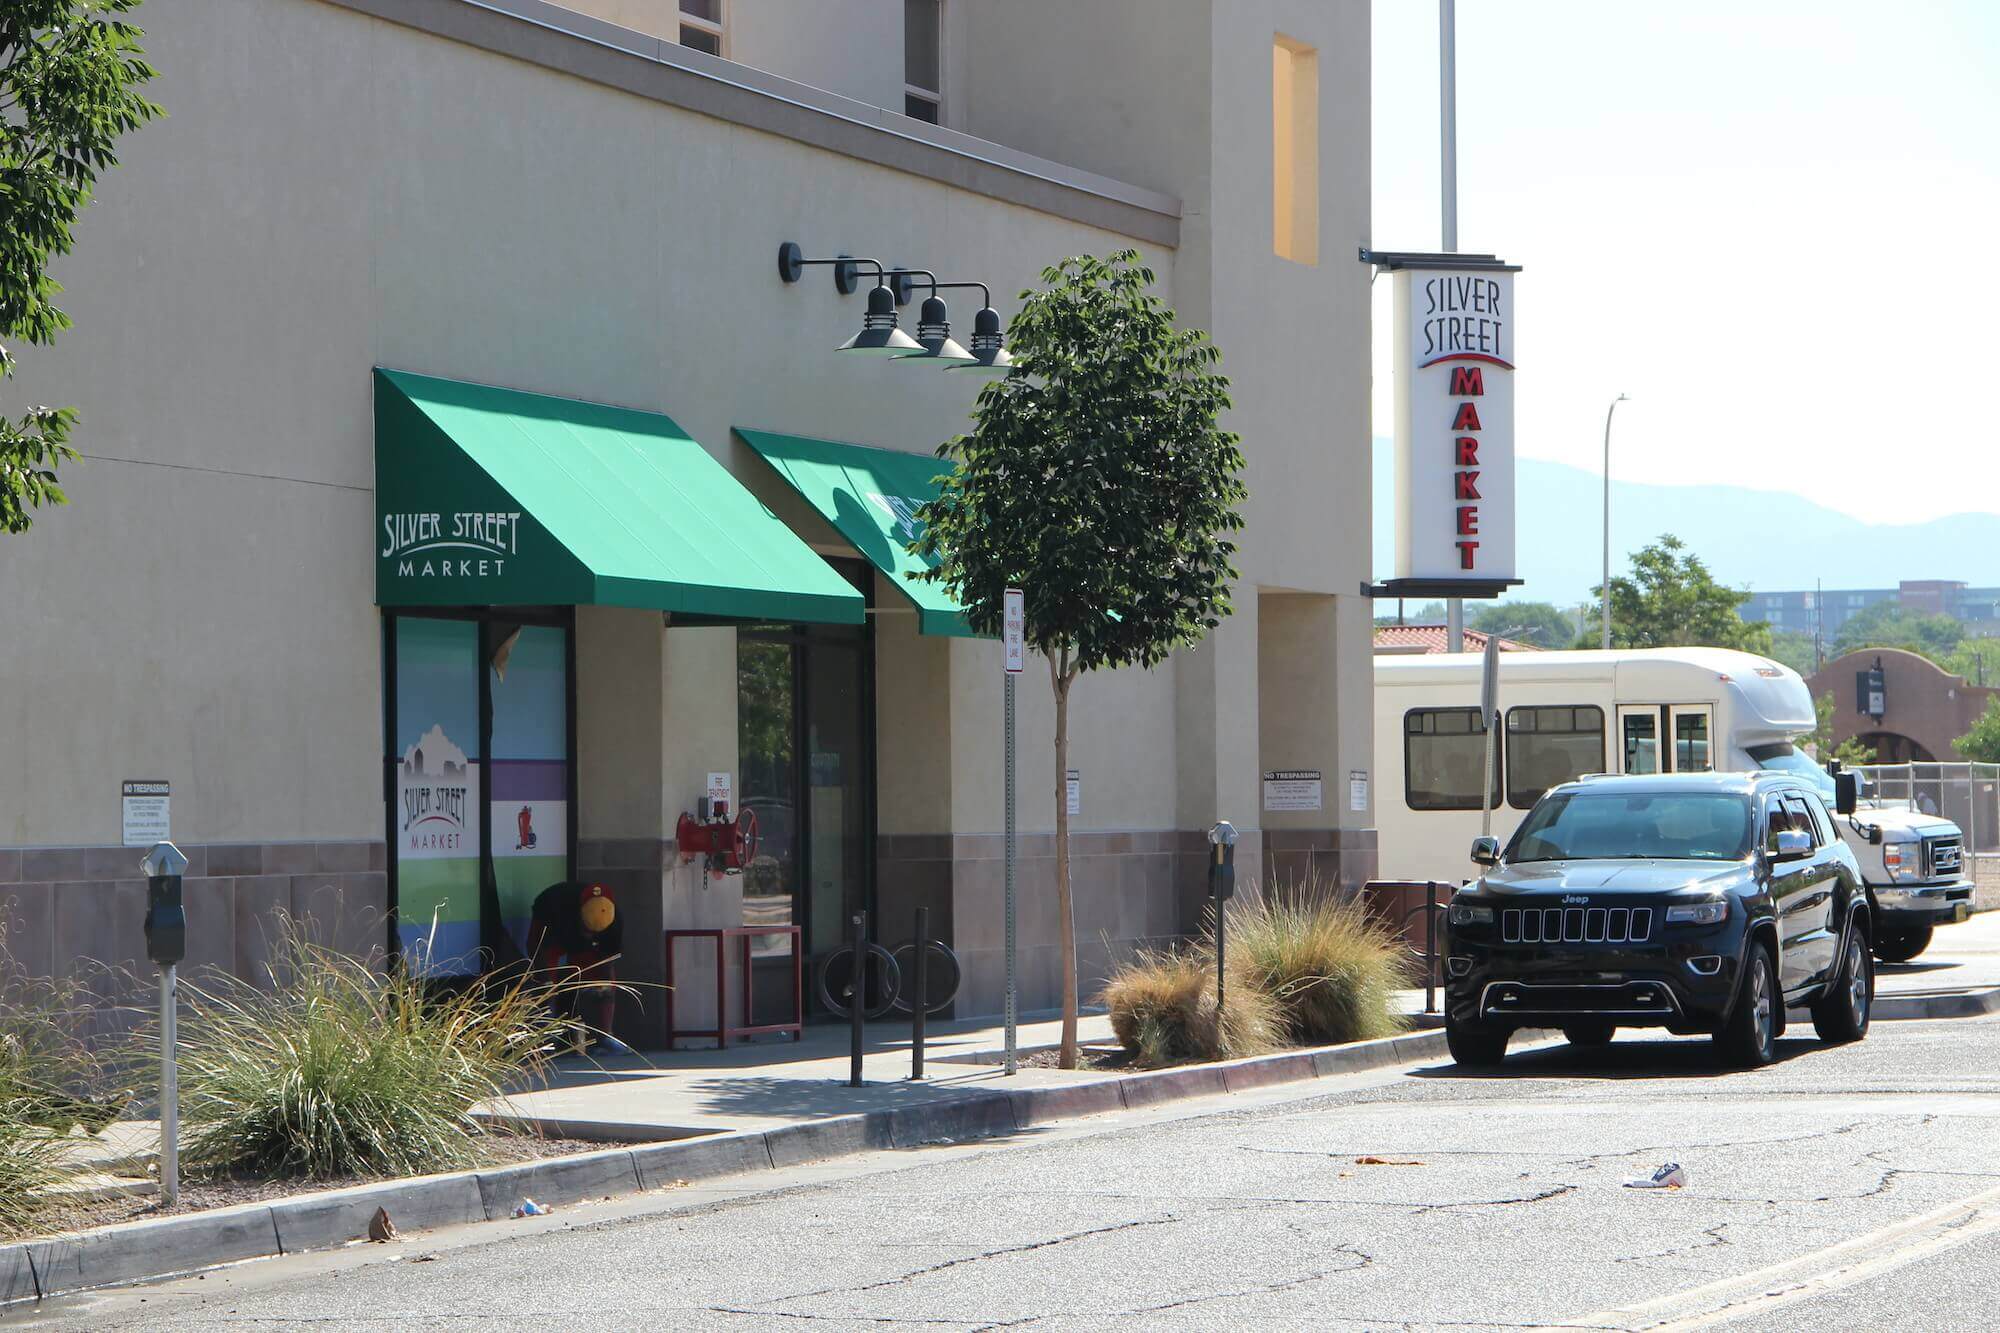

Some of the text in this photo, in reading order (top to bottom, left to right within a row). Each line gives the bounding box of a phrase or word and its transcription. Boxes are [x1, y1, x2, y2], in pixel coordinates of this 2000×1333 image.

[1425, 276, 1500, 316] SILVER
[1424, 317, 1502, 355] STREET
[1449, 366, 1484, 569] MARKET
[382, 512, 520, 557] SILVER STREET
[399, 560, 504, 577] MARKET
[134, 784, 169, 793] TRESPASSING
[404, 787, 466, 832] SILVER STREET
[411, 833, 461, 849] MARKET
[1561, 894, 1589, 905] Jeep
